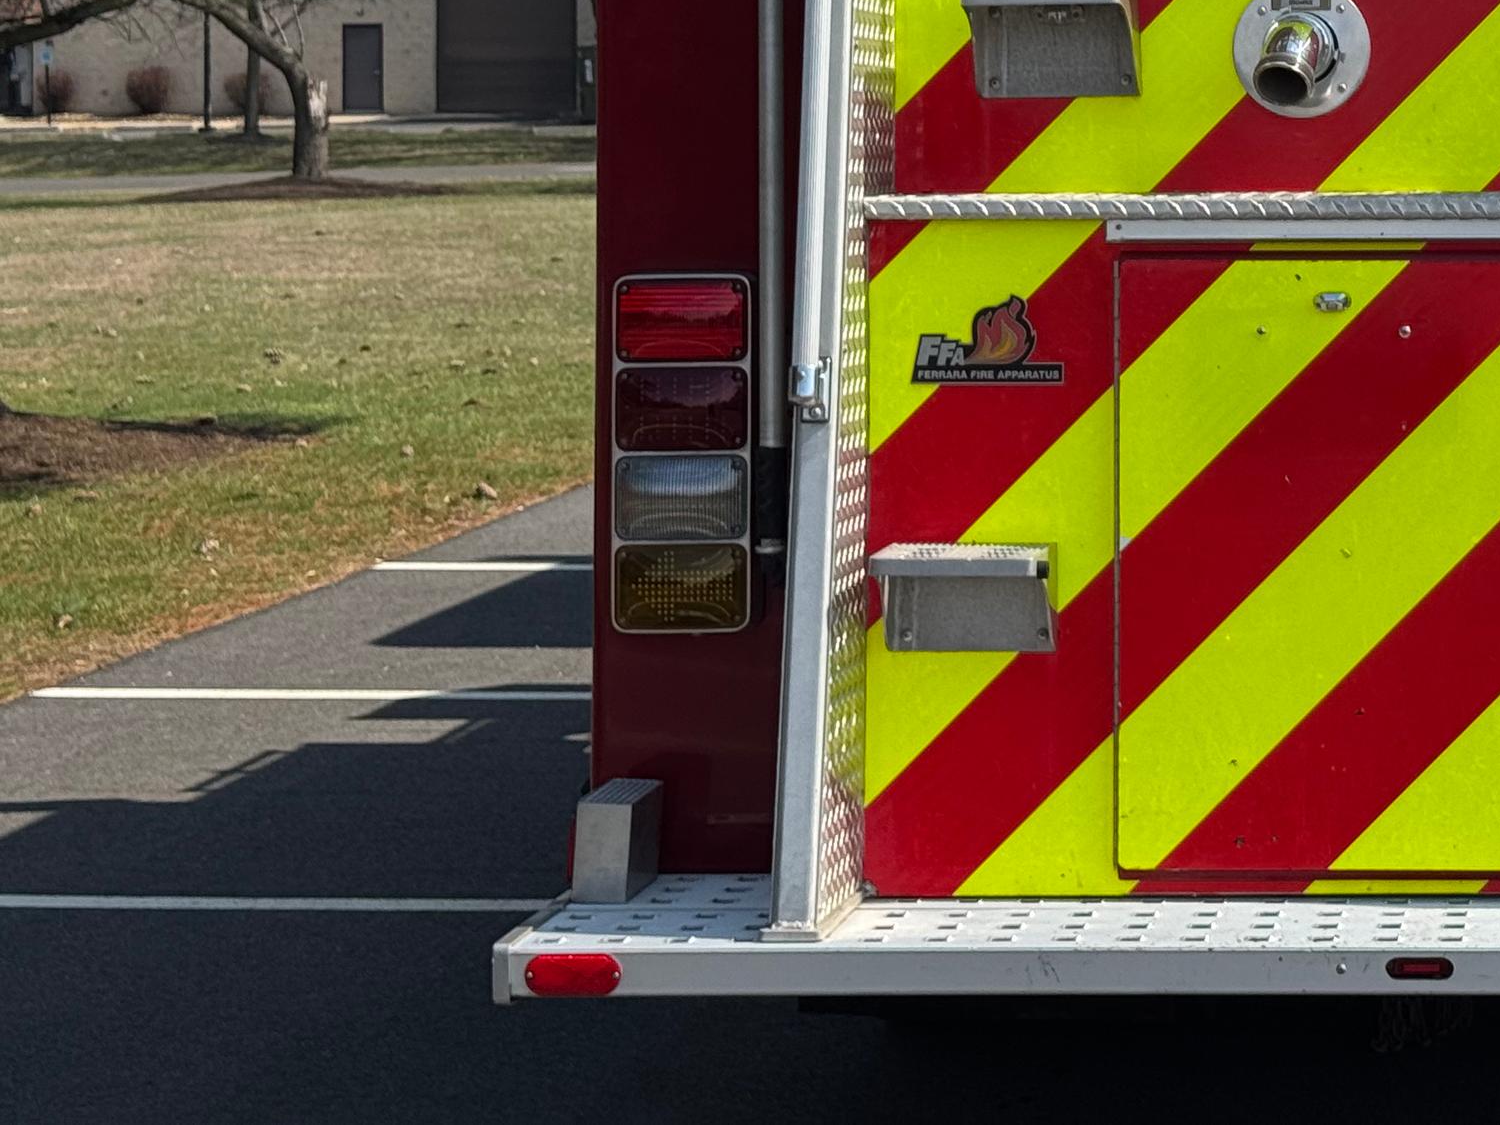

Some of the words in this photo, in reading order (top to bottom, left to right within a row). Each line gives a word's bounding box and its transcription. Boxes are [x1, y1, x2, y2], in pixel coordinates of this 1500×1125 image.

[916, 336, 965, 366] FFA
[917, 369, 967, 379] FERRARA
[970, 369, 994, 379] FIRE
[997, 369, 1059, 379] APPARATUS
